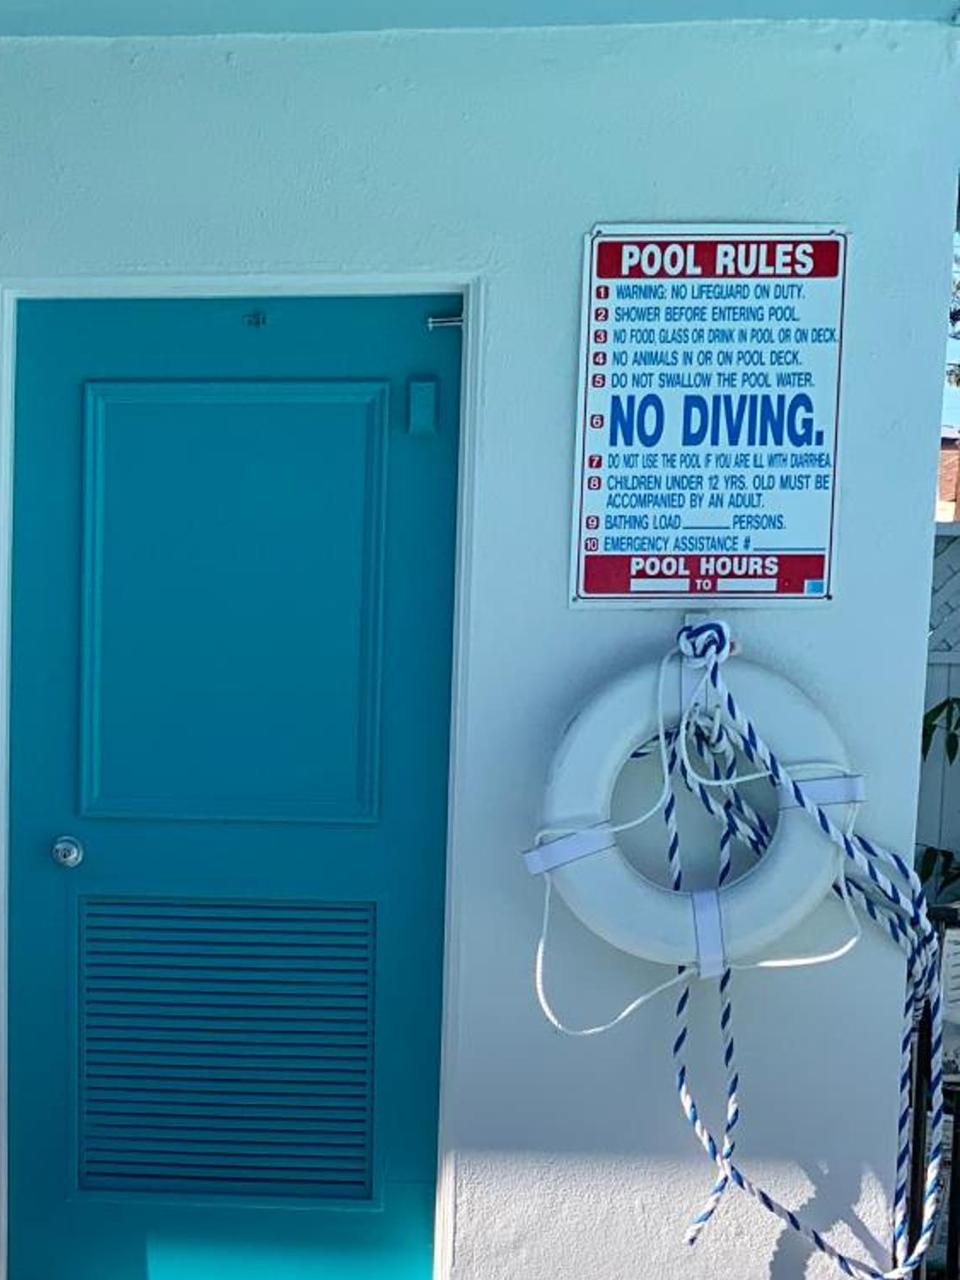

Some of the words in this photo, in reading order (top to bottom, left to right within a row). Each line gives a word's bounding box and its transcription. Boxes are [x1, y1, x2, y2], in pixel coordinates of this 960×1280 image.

[621, 244, 702, 276] POOL
[715, 243, 814, 275] RULES
[616, 284, 667, 300] WARNING:
[671, 284, 687, 300] NO
[691, 284, 750, 300] LIFEGUARD
[754, 284, 770, 299] ON
[774, 284, 806, 299] DUTY.
[615, 306, 661, 322] SHOWER
[665, 306, 707, 322] BEFORE
[712, 306, 765, 321] ENTERING
[769, 306, 801, 321] POOL.
[614, 328, 626, 344] NO
[630, 328, 657, 345] FOOD,
[659, 328, 689, 343] GLASS
[691, 328, 704, 344] OR
[707, 328, 735, 343] DRINK
[738, 328, 748, 343] IN
[750, 328, 775, 344] POOL
[778, 328, 791, 343] OR
[794, 328, 808, 343] ON
[811, 328, 839, 343] DECK.
[613, 351, 628, 366] NO
[632, 350, 678, 366] ANIMALS
[683, 351, 693, 366] IN
[697, 350, 713, 366] OR
[717, 350, 733, 366] ON
[737, 350, 766, 366] POOL
[770, 350, 802, 366] DECK.
[612, 373, 627, 388] DO
[632, 372, 654, 388] NOT
[658, 372, 712, 388] SWALLOW
[717, 372, 737, 388] THE
[741, 372, 772, 388] POOL
[776, 372, 815, 387] WATER.
[609, 394, 665, 448] NO
[681, 393, 824, 447] DIVING.
[607, 454, 620, 469] DO
[623, 454, 639, 469] NOT
[642, 453, 659, 469] USE
[662, 453, 678, 468] THE
[680, 453, 701, 468] POOL
[704, 453, 712, 468] IF
[715, 453, 731, 468] YOU
[733, 453, 750, 468] ARE
[753, 454, 764, 468] ILL
[767, 453, 788, 468] WITH
[607, 475, 662, 490] CHILDREN
[666, 475, 703, 490] UNDER
[708, 475, 719, 490] 12
[724, 475, 747, 490] YRS.
[753, 475, 775, 490] OLD
[780, 474, 811, 490] MUST
[815, 474, 829, 490] BE
[606, 493, 685, 509] ACCOMPANIED
[690, 493, 704, 509] BY
[708, 493, 723, 508] AN
[727, 493, 765, 508] ADULT.
[605, 515, 649, 530] BATHING
[653, 515, 681, 530] LOAD
[733, 514, 786, 530] PERSONS.
[585, 539, 598, 550] 10
[604, 536, 669, 551] EMERGENCY
[673, 536, 739, 551] ASSISTANCE
[743, 536, 751, 551] #
[630, 557, 690, 576] POOL
[700, 557, 779, 576] HOURS
[696, 579, 711, 590] TO
